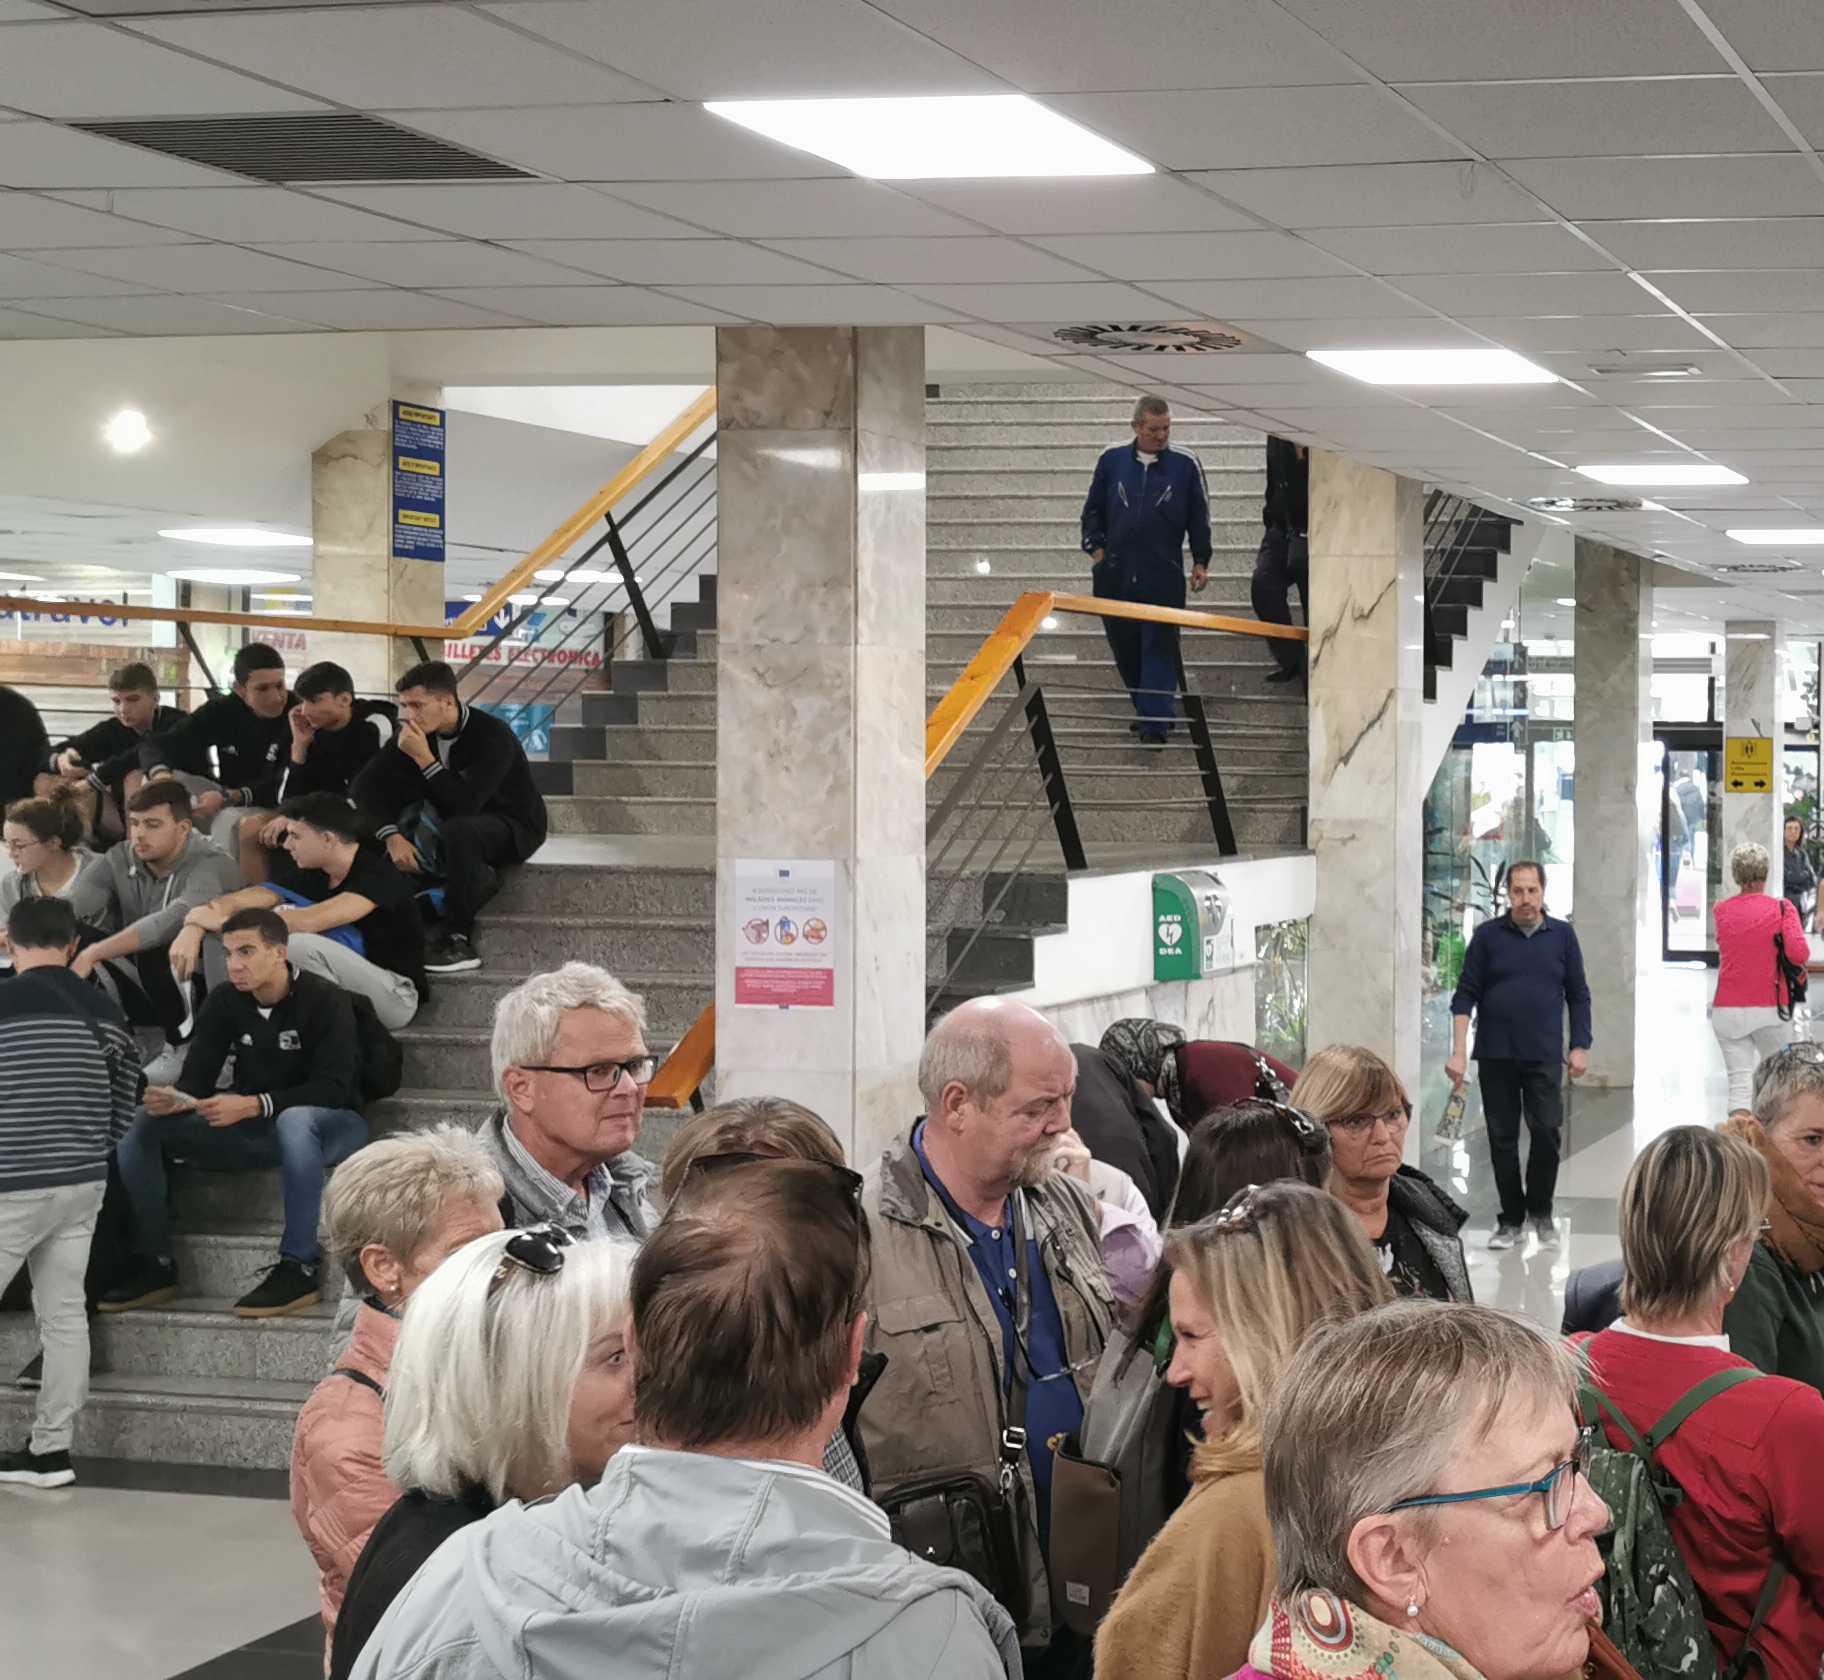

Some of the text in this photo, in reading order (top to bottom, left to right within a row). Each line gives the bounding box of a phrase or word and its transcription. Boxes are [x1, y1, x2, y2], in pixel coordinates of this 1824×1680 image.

[447, 643, 601, 667] ILLETES ELECTRONICA
[1158, 914, 1182, 923] AED
[1158, 947, 1183, 956] DEA
